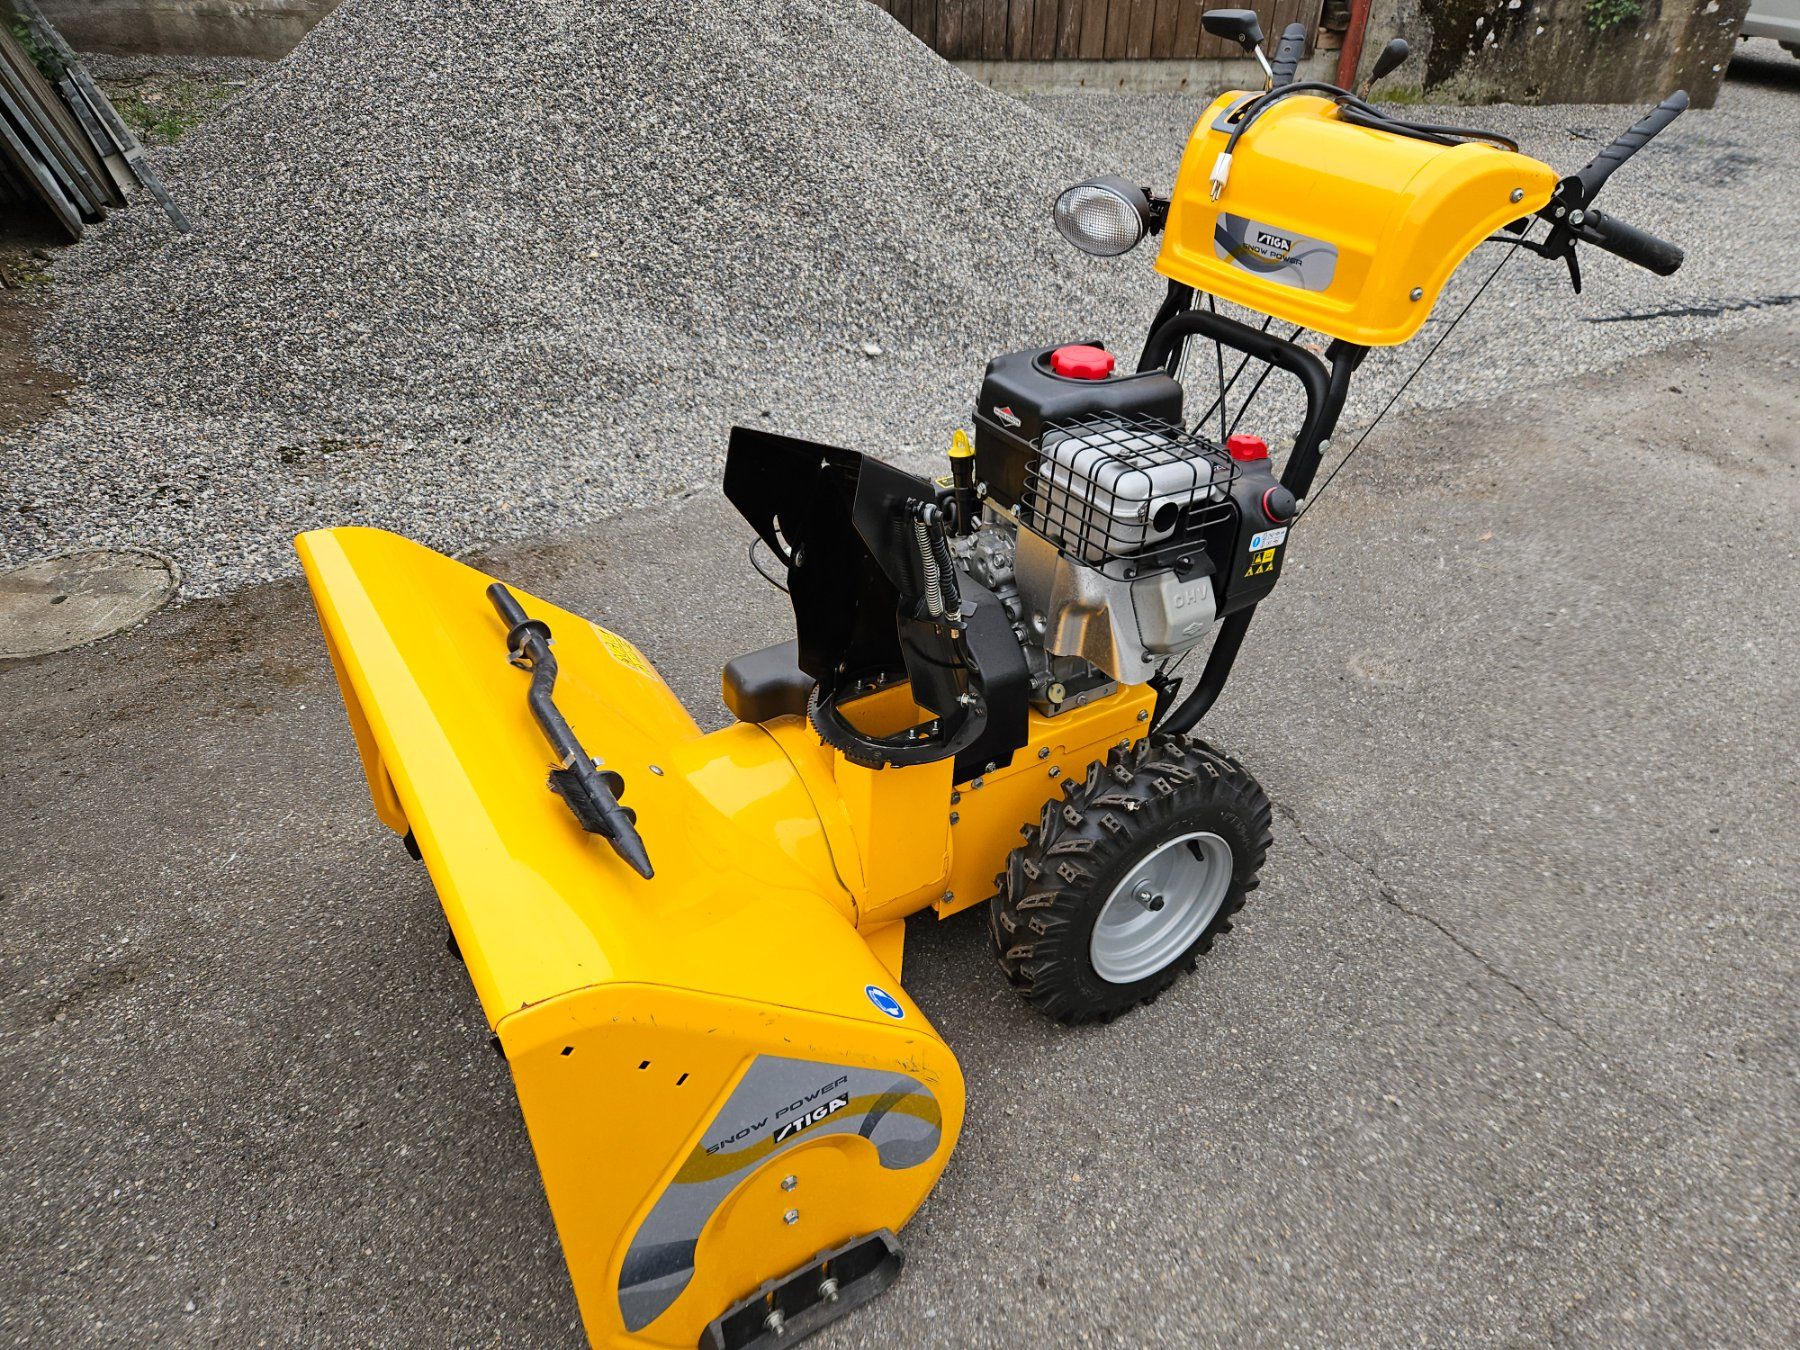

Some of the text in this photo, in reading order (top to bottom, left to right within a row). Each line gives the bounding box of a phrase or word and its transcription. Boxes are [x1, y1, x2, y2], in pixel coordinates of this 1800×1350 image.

[1242, 242, 1303, 266] SNOW POWER
[1258, 233, 1290, 251] STIGA
[1174, 583, 1208, 609] OHV
[706, 1075, 848, 1156] SNOW POWER
[776, 1096, 848, 1143] STIGA
